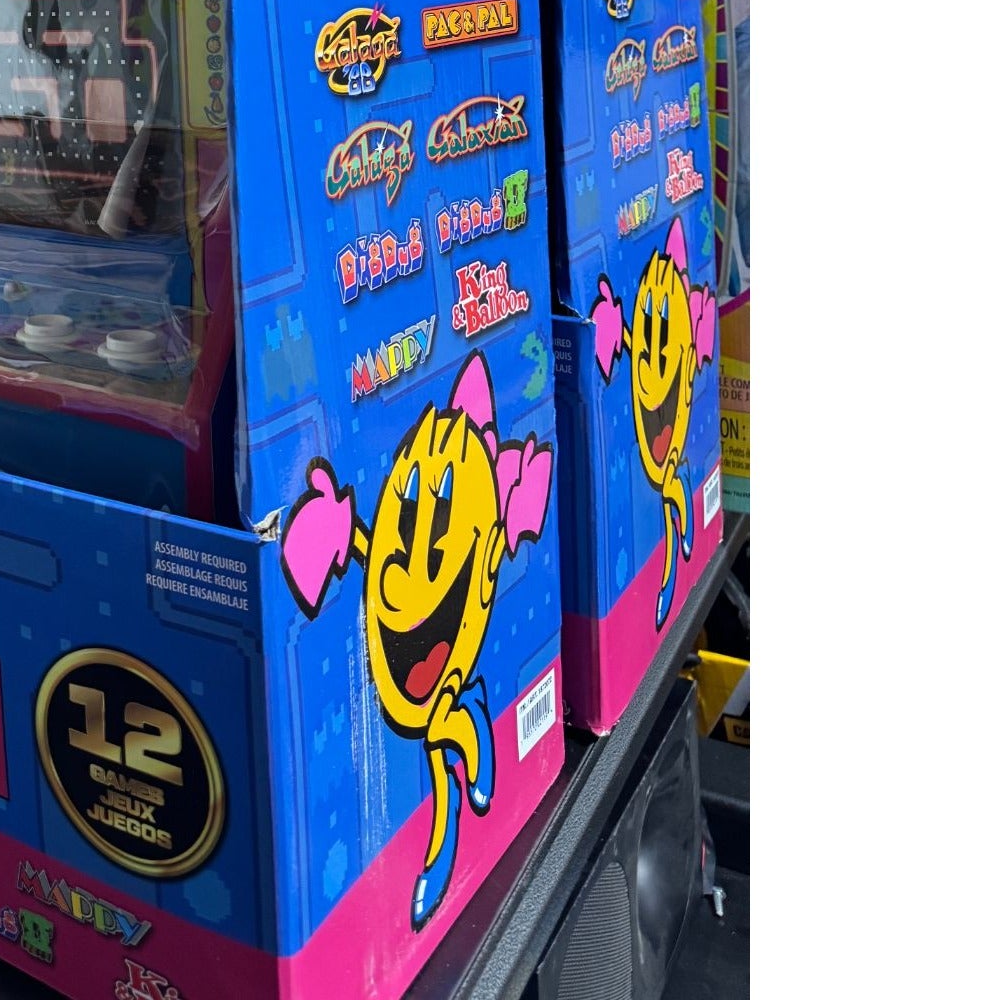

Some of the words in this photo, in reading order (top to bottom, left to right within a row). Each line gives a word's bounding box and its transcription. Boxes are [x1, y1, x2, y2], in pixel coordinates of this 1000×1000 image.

[425, 10, 463, 41] PAC
[463, 10, 475, 33] &
[476, 1, 514, 31] PAL
[455, 260, 510, 303] King
[452, 303, 465, 331] &
[464, 290, 530, 338] Balloon
[351, 314, 437, 403] MAPPY
[154, 541, 199, 561] ASSEMBLY
[201, 552, 247, 574] REQUIRED
[155, 559, 213, 583] ASSEMBLAGE
[214, 573, 248, 592] REQUIS
[146, 573, 188, 595] REQUIERE
[189, 584, 249, 611] ENSAMBLAJE
[68, 682, 184, 787] 12
[89, 763, 165, 807] GAMES
[100, 789, 156, 824] JEUX
[86, 802, 173, 850] JUEGOS
[16, 859, 153, 947] MAPPY
